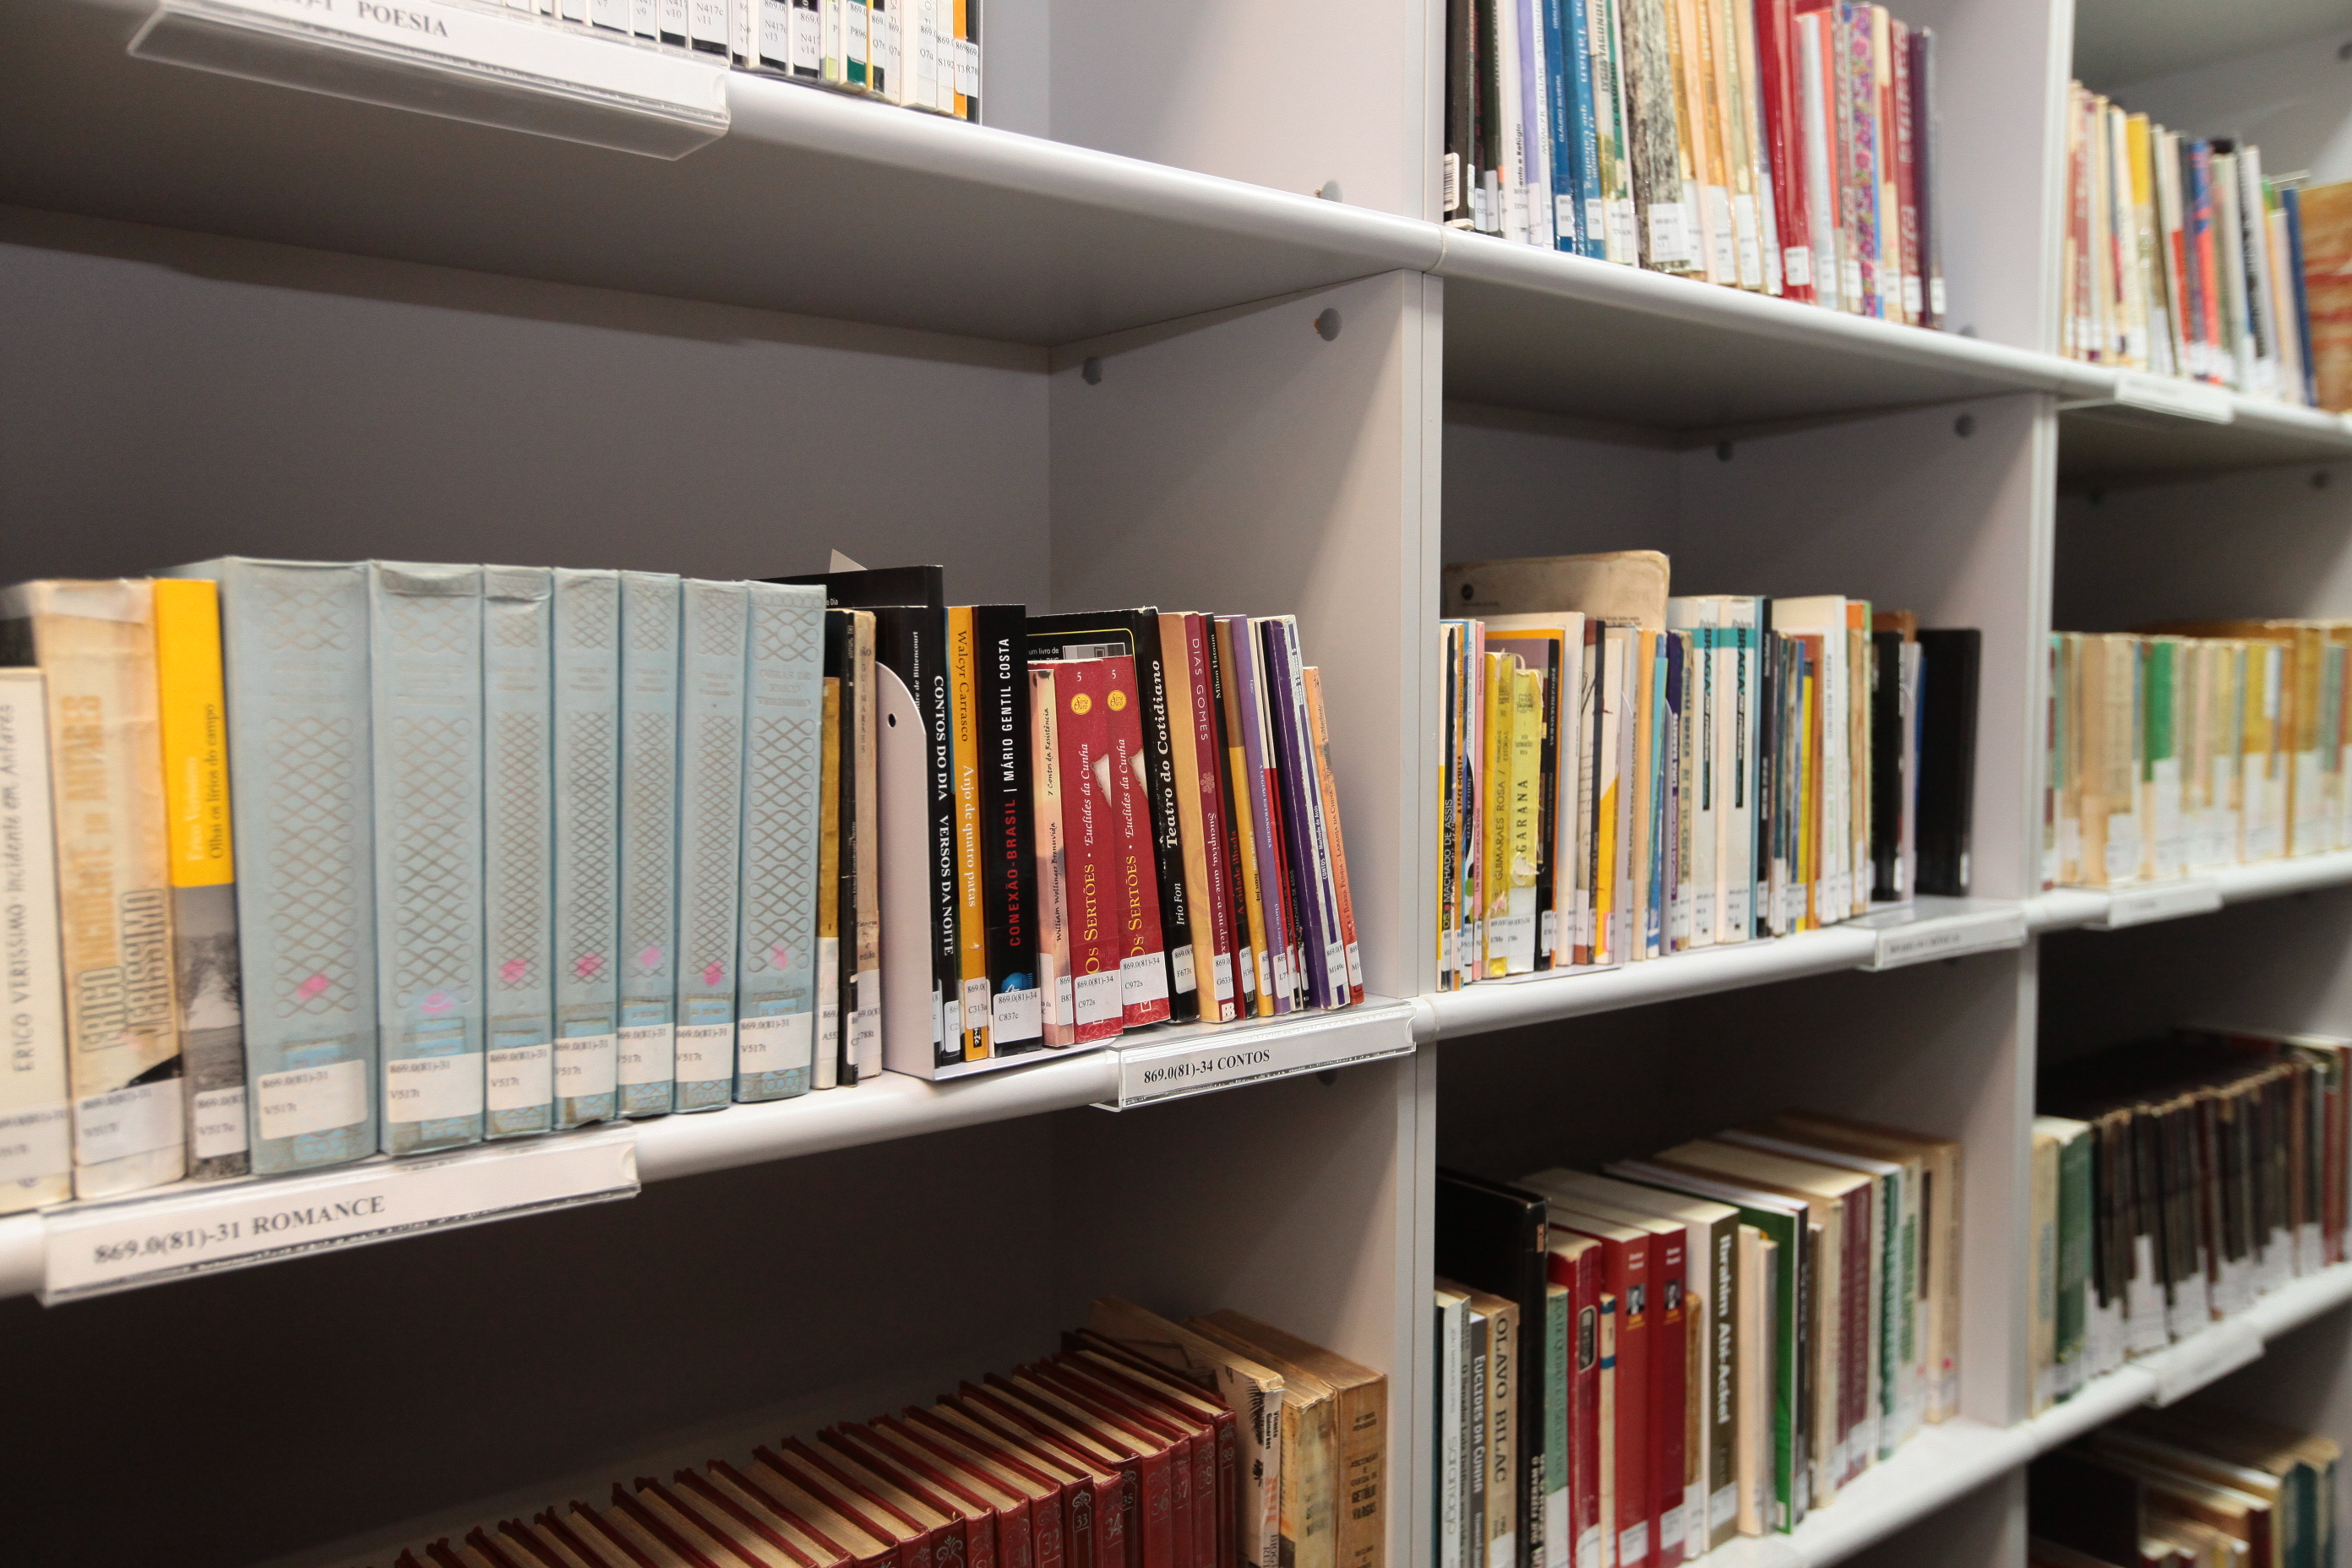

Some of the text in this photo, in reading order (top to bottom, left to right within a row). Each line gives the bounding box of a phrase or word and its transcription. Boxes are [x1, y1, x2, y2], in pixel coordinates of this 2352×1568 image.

[357, 2, 449, 38] POESIA
[696, 3, 724, 17] N417c
[765, 32, 779, 42] v13
[802, 46, 816, 57] v14
[1515, 123, 1523, 156] Refúgio
[1038, 647, 1051, 656] livro
[1051, 646, 1059, 655] de
[1211, 634, 1222, 699] Milton Hatoum
[1703, 629, 1712, 694] BRAGA
[1737, 628, 1746, 694] BRAGA
[956, 630, 970, 743] Walcyr Carrasco
[1076, 672, 1082, 682] 5
[1111, 669, 1117, 679] 5
[1192, 637, 1209, 742] DIAS GOMES
[1043, 707, 1053, 751] Resistência
[1045, 752, 1053, 763] da
[1078, 743, 1091, 779] Cunha
[1116, 738, 1129, 774] Cunha
[1152, 660, 1179, 849] Teatro do Cotidiano
[204, 704, 225, 860] Olhai os do campo
[999, 638, 1021, 946] CONEXÃO-BRASIL MÁRIO GENTIL COSTA
[1081, 781, 1091, 797] da
[1119, 775, 1130, 790] da
[1259, 770, 1267, 797] LEGIÃO
[1495, 781, 1505, 811] ROSA
[933, 675, 954, 956] CONTOS DO DIA VERSOS DA NOITE
[1081, 798, 1094, 847] Euclides
[1119, 791, 1135, 839] Euclides
[1261, 798, 1272, 848] ESTRANGEIRA
[1516, 780, 1529, 858] GARANA
[961, 765, 977, 907] Anjo de quatro patas
[1442, 798, 1454, 903] MACHADO DE ASSIS
[1207, 813, 1225, 926] Sucupira, ame-a ou
[1229, 830, 1246, 915] A cidade ilhada
[1320, 858, 1329, 880] CONTOS
[1173, 881, 1186, 926] Irio Fon
[1291, 887, 1298, 897] DE
[5, 904, 31, 1004] VERISSIMO
[121, 888, 173, 1037] VERISSIMO
[1123, 957, 1160, 971] 869.0(81)-34
[1329, 964, 1344, 975] M149c
[1077, 975, 1114, 989] 869.0(81)-34
[1124, 980, 1144, 990] C972s
[1177, 967, 1192, 977] F673t
[77, 966, 128, 1054] ERICO
[968, 1004, 988, 1014] C313a
[999, 991, 1037, 1004] 869.0(81)-34
[1078, 999, 1096, 1009] C972s
[999, 1013, 1019, 1022] C837c
[10, 1013, 35, 1071] ERICO
[1143, 1048, 1271, 1085] 869.0(81)-34 CONTOS
[95, 1195, 386, 1264] 869.0(81)-31 ROMANCE
[1718, 1233, 1732, 1318] Ibrahim
[1493, 1316, 1509, 1484] OLAVO BILAC
[1272, 1410, 1281, 1439] Vicente
[1473, 1355, 1486, 1494] EUCLIDES DA CUNHA
[1222, 1446, 1233, 1463] 39
[1173, 1478, 1189, 1503] 37
[1197, 1466, 1213, 1489] 38
[1122, 1494, 1134, 1506] 35
[1152, 1488, 1169, 1516] 36
[1076, 1513, 1089, 1529] 33
[1106, 1513, 1124, 1541] 34
[1043, 1527, 1060, 1555] 32
